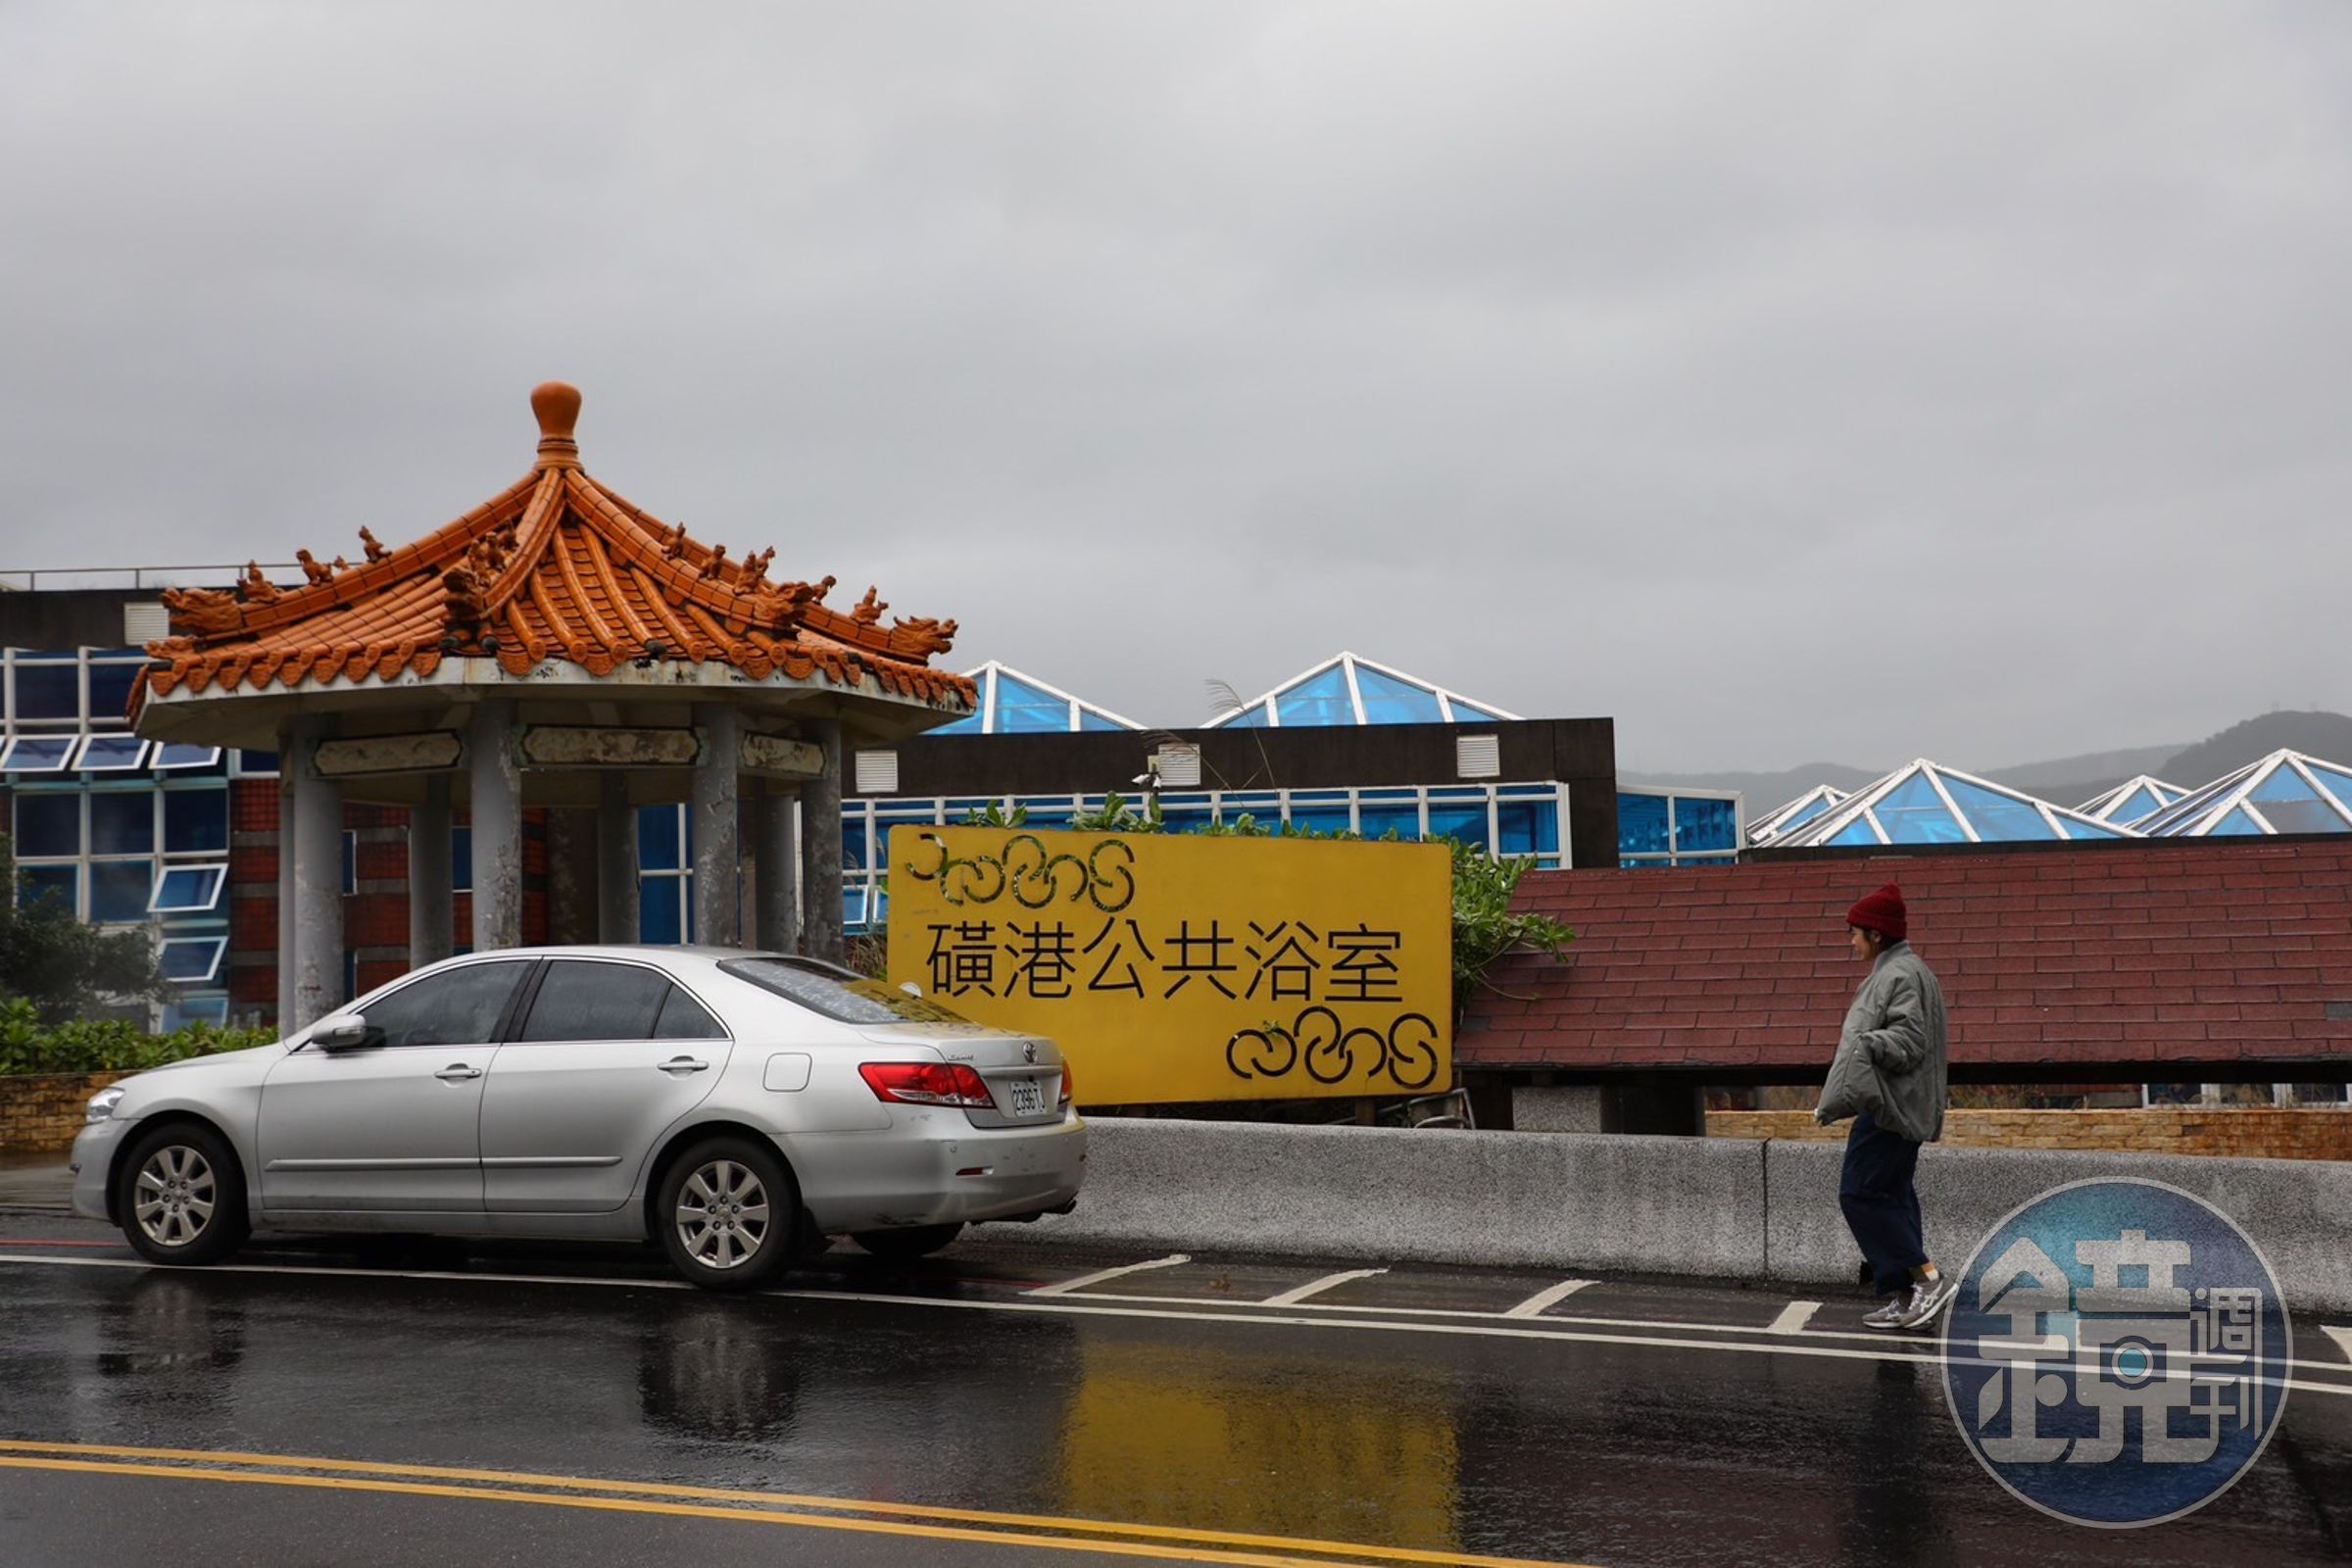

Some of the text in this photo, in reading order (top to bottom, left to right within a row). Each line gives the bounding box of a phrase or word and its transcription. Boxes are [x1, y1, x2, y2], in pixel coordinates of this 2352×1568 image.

[926, 916, 1402, 1002] 磺港公共浴室
